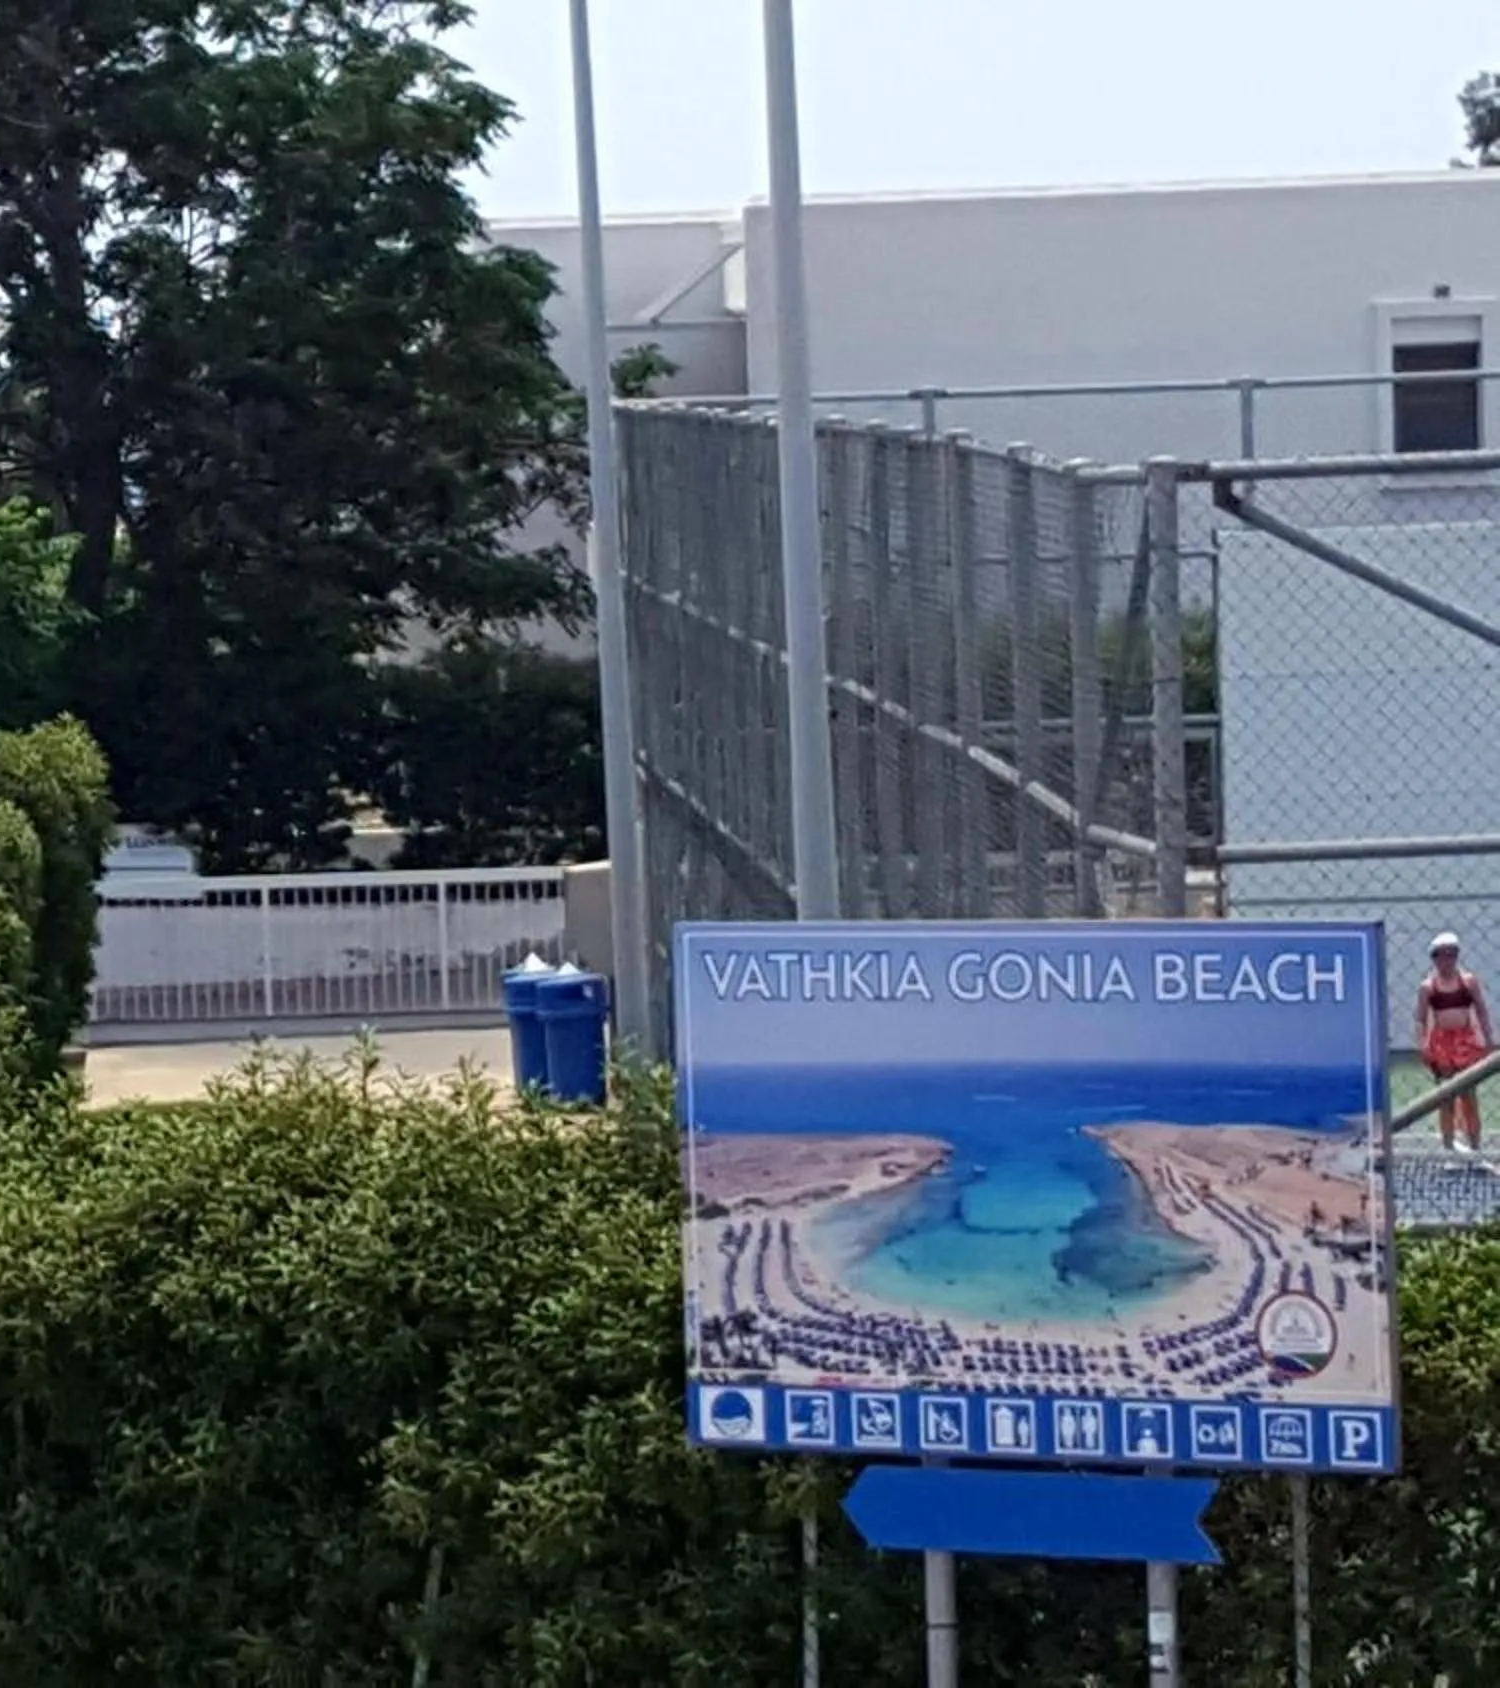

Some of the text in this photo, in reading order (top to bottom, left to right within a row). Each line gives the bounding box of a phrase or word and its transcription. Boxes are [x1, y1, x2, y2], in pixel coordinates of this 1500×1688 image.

[703, 951, 1346, 1002] VATHKIA GONIA BEACH
[1341, 1419, 1370, 1459] P
